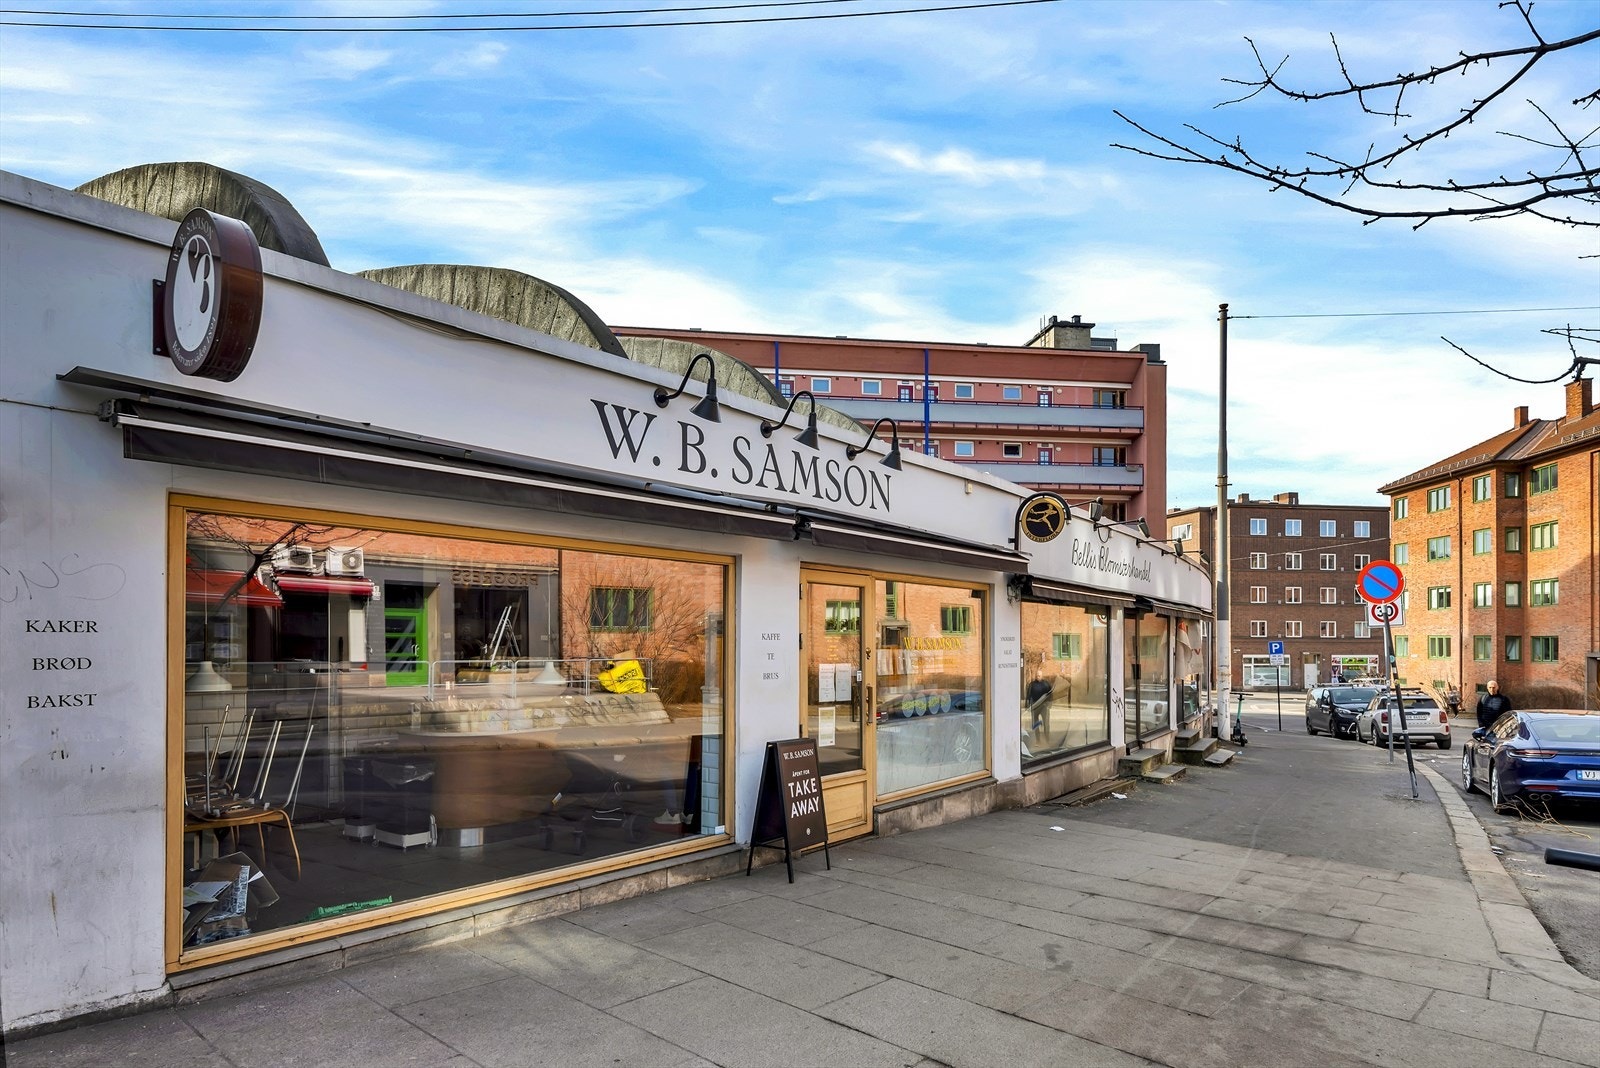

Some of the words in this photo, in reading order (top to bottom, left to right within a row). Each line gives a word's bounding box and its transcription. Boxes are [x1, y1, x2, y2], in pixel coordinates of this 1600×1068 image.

[590, 398, 661, 467] W.
[677, 420, 718, 479] B.
[732, 435, 892, 513] SAMSON
[1072, 538, 1096, 570] Bellis
[1098, 545, 1152, 583] Blomsterhandel
[1376, 605, 1394, 618] 30
[25, 619, 98, 633] KAKER
[761, 632, 781, 641] KAFFE
[925, 636, 962, 650] SAMSON
[1271, 643, 1280, 653] P
[767, 652, 775, 661] TE
[32, 657, 92, 671] BRØD
[762, 672, 780, 680] BRUS
[27, 693, 97, 709] BAKST
[794, 748, 814, 759] SAMSON
[788, 777, 818, 798] TAKE
[791, 796, 820, 819] AWAY
